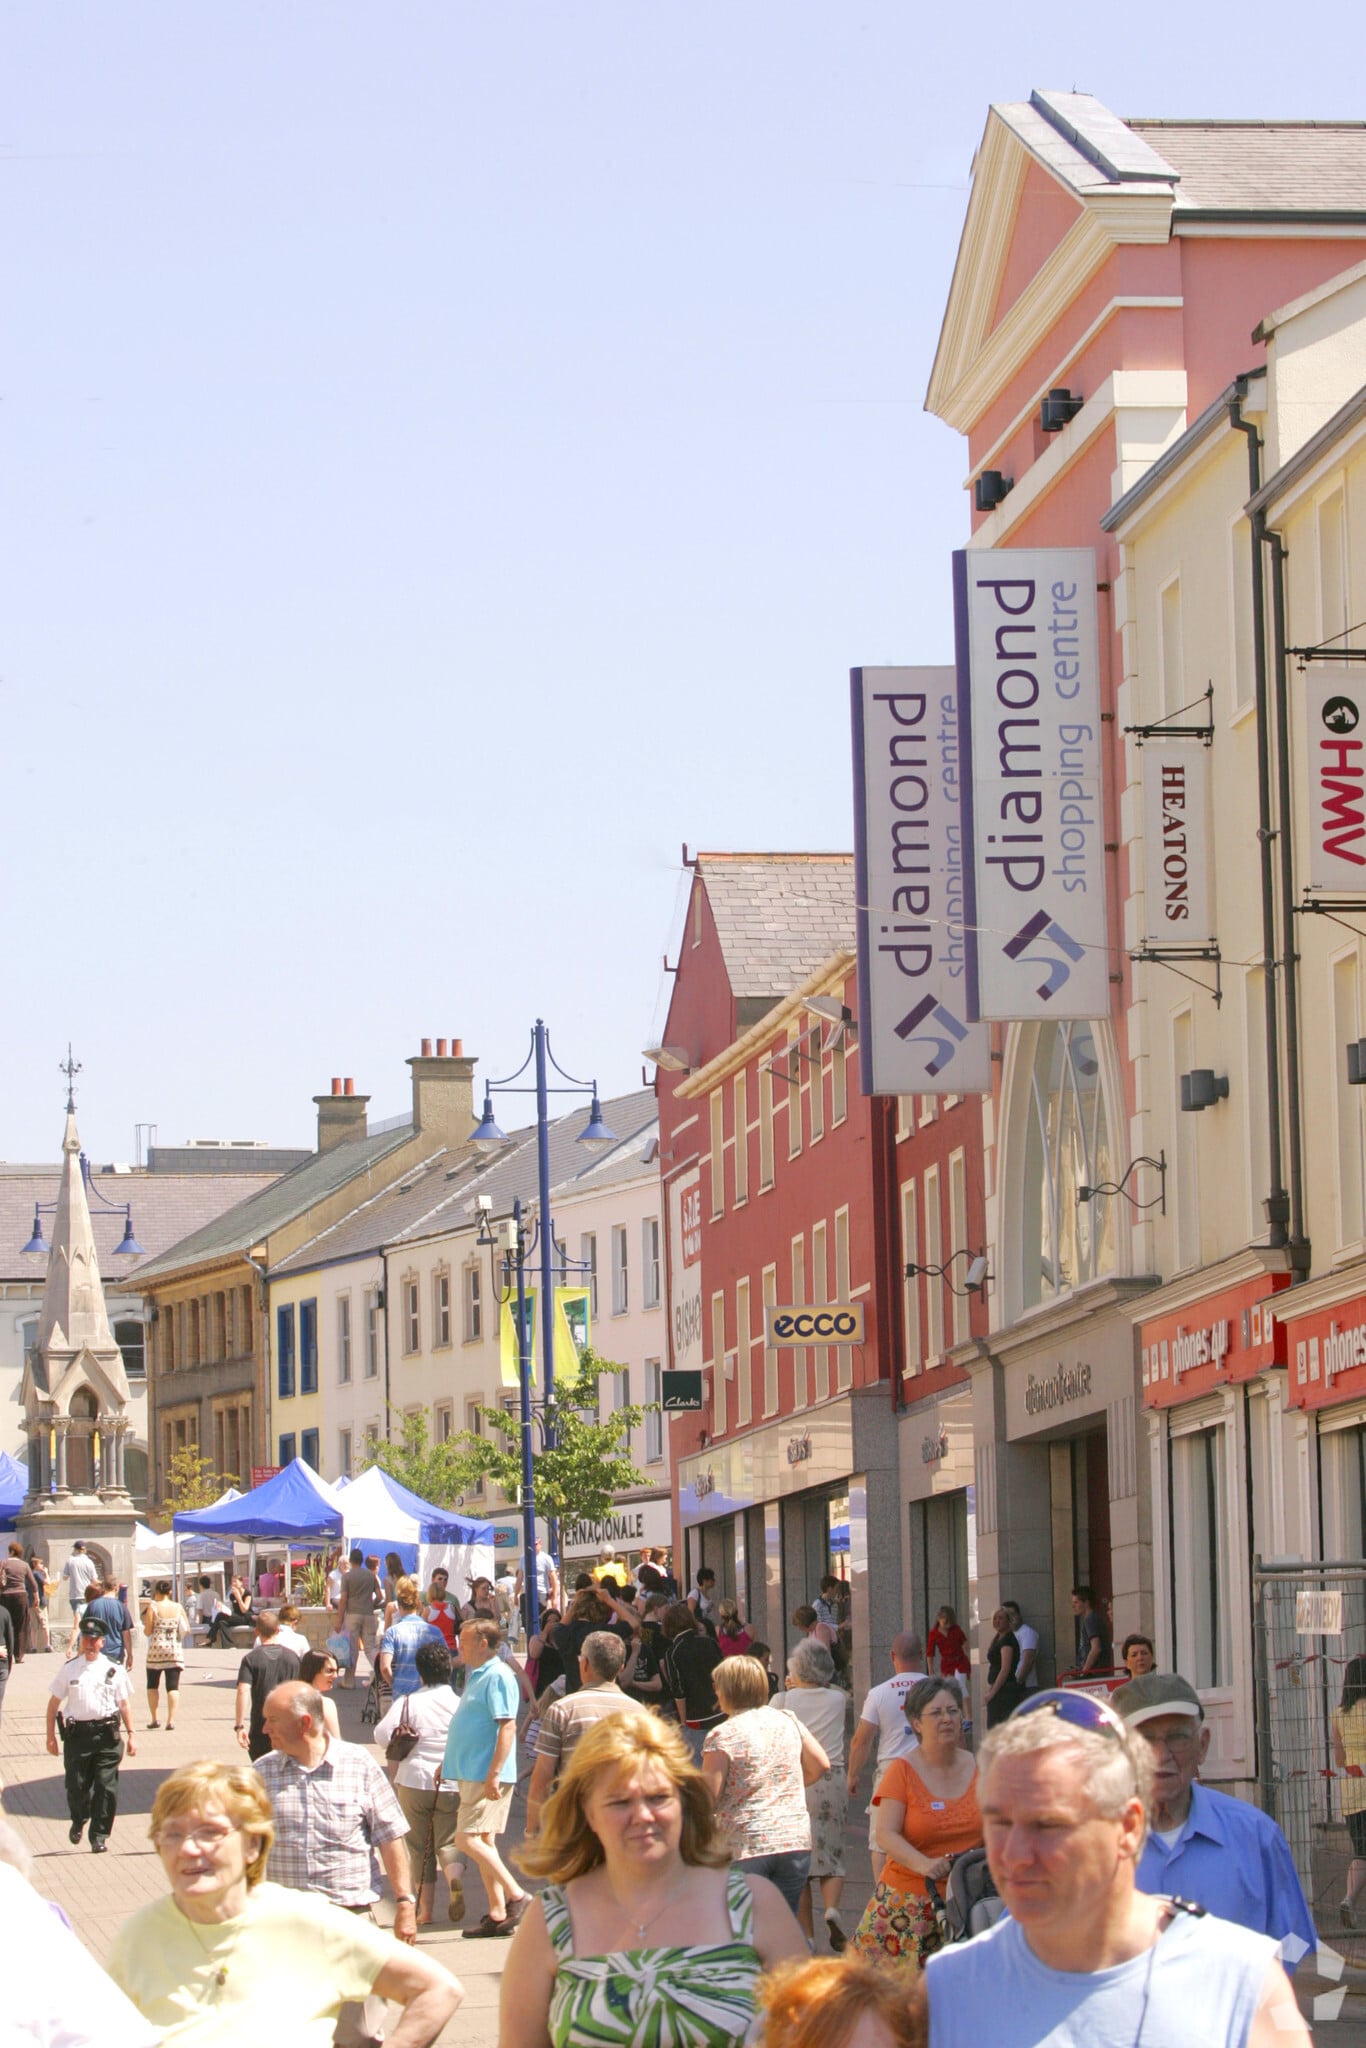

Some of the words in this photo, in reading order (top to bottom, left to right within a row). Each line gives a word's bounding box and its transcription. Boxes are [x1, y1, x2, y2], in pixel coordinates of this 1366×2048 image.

[1048, 581, 1080, 700] centre
[976, 580, 1045, 893] diamond
[873, 694, 932, 978] diamond
[1052, 724, 1094, 893] shopping
[1162, 765, 1189, 921] HEATONS
[1320, 740, 1366, 866] HMV
[683, 1190, 701, 1232] SALE
[774, 1312, 856, 1338] ecco
[1171, 1324, 1211, 1386] phones
[664, 1396, 701, 1407] Clarks
